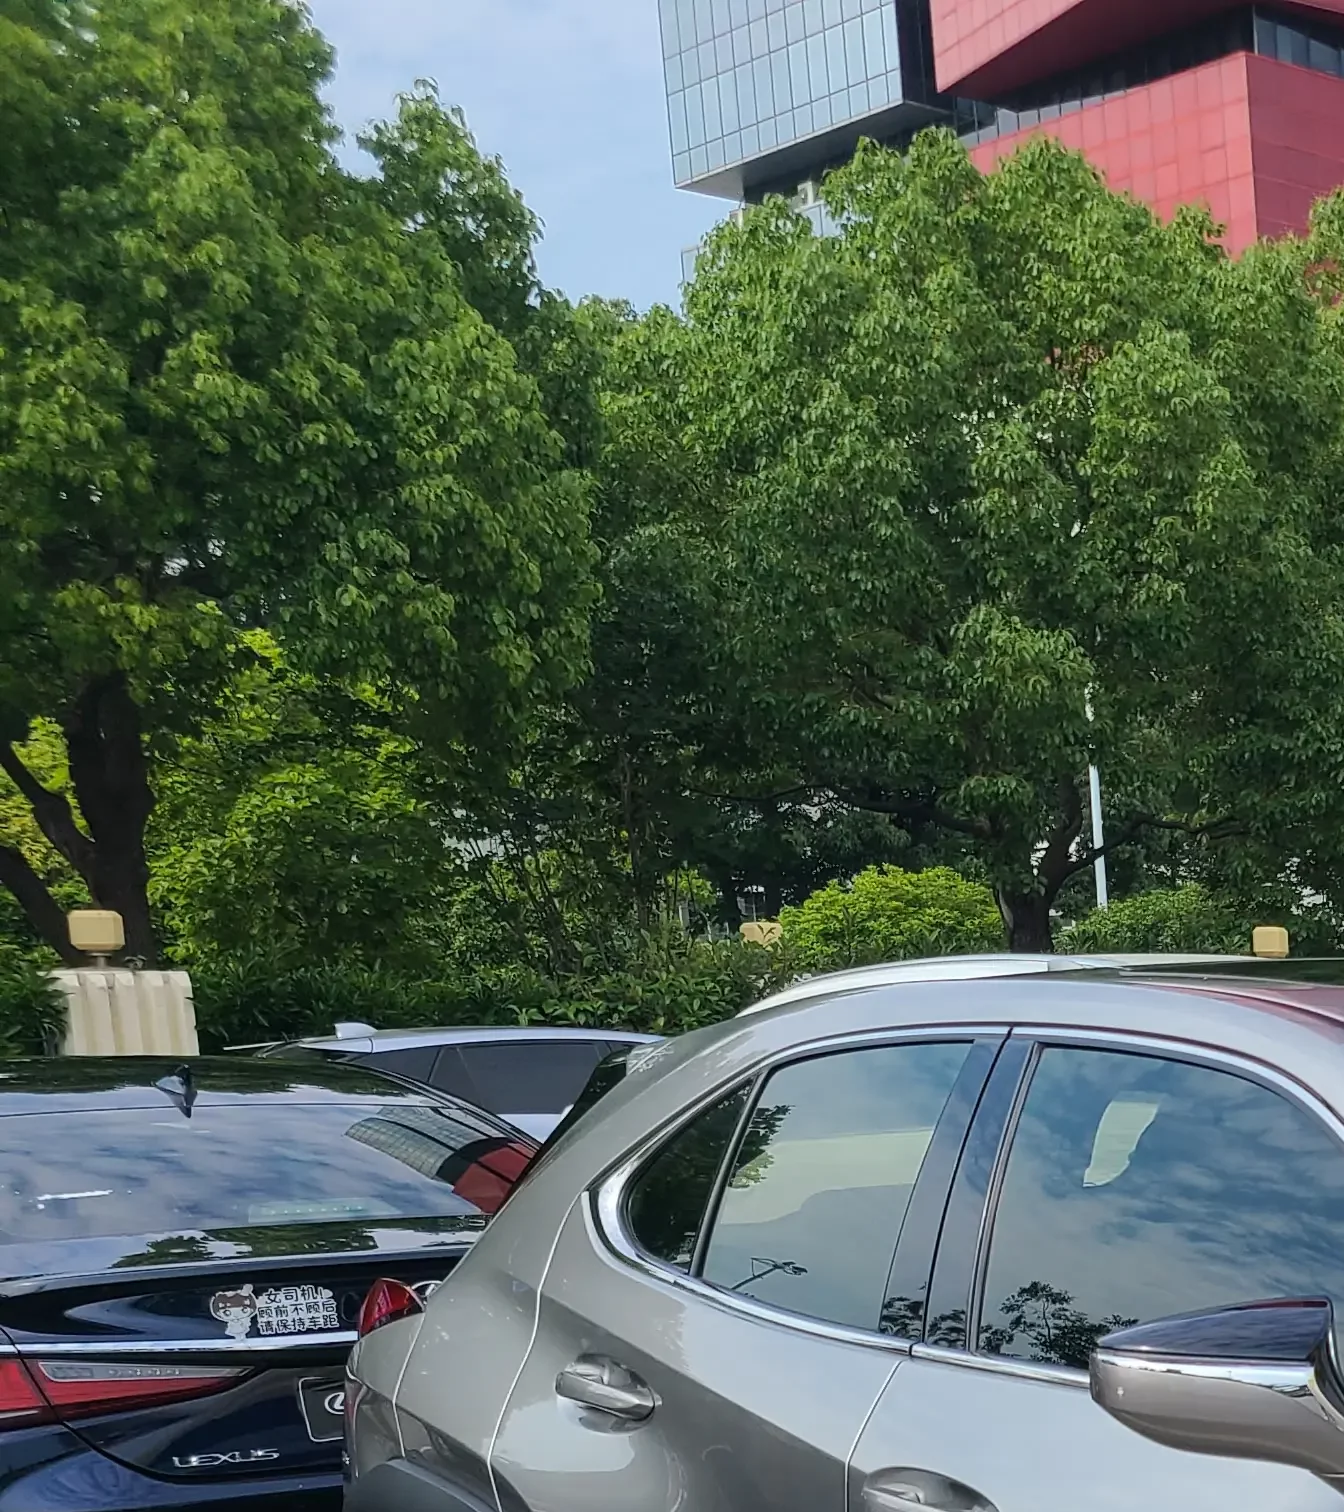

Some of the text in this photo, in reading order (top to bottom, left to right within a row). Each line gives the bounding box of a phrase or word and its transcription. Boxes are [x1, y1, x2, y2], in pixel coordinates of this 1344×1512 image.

[259, 1301, 337, 1318] 顾前不顾后
[260, 1315, 338, 1333] 请保持车距
[172, 1449, 280, 1468] LEXUS
